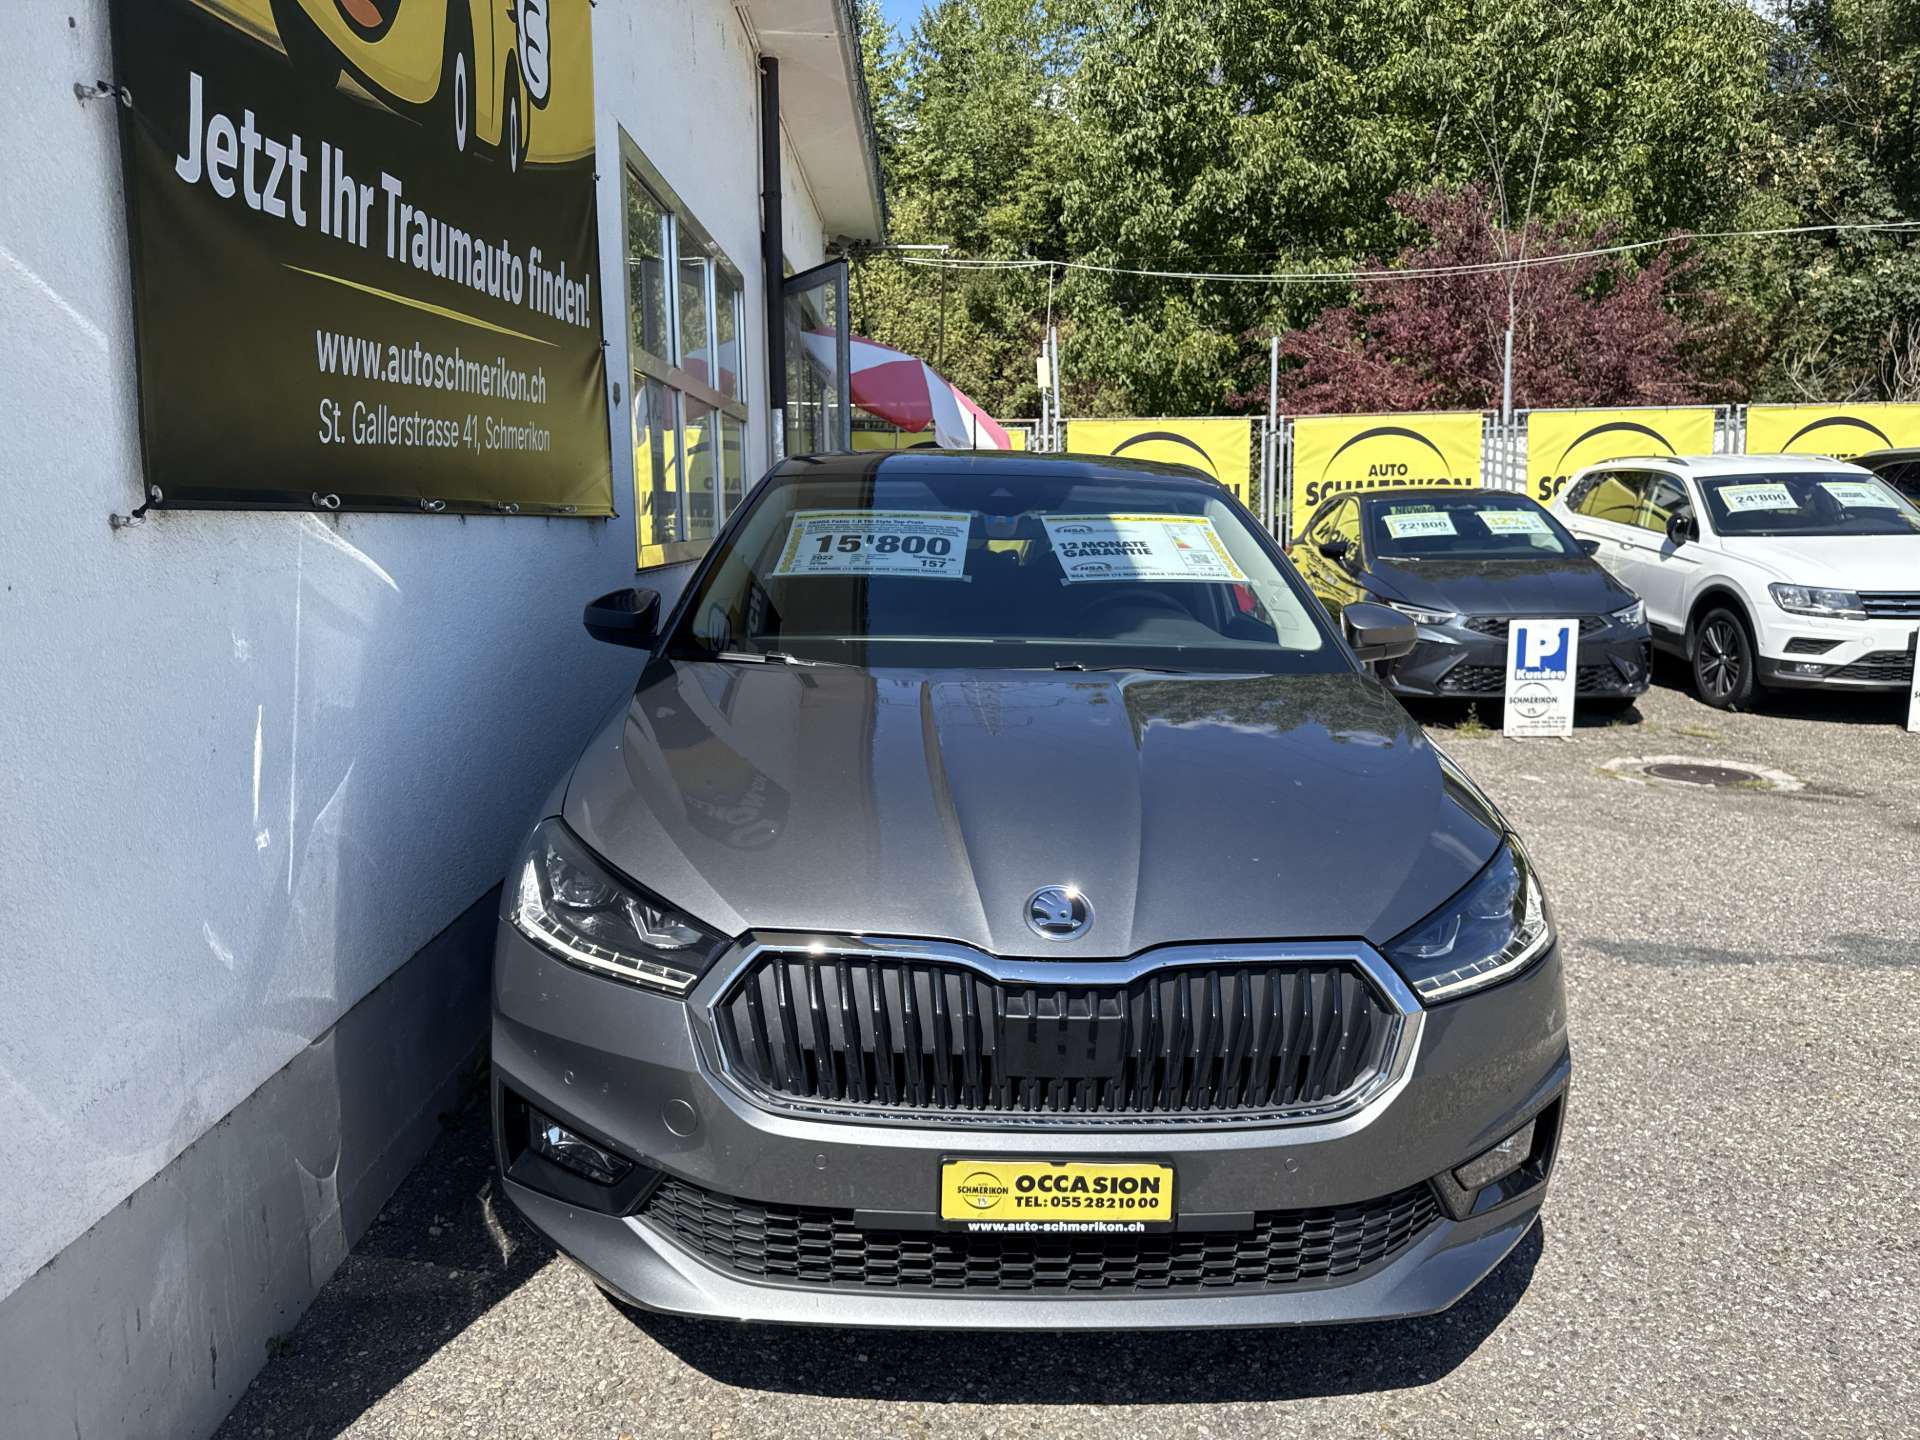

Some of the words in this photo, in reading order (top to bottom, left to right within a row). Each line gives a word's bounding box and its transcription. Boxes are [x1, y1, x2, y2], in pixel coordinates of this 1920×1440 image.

[175, 71, 308, 227] Jetzt
[320, 140, 374, 248] Ihr
[381, 171, 523, 305] Traumauto
[528, 246, 590, 329] finden!
[316, 329, 547, 404] www.autoschmerikon.ch
[318, 397, 345, 444] St.
[352, 400, 459, 447] Gallerstrasse
[463, 413, 481, 456] 41,
[485, 415, 550, 452] Schmerikon
[1368, 463, 1408, 477] AUTO
[816, 534, 952, 556] 15'800
[1059, 542, 1079, 550] 12
[1081, 540, 1148, 549] MONATE
[1063, 548, 1153, 558] GARANTIE
[920, 559, 947, 568] 157
[957, 1185, 1009, 1195] SCHMERIKON
[1014, 1174, 1160, 1195] OCCASION
[967, 1220, 1146, 1233] www.auto-schmerikon.ch
